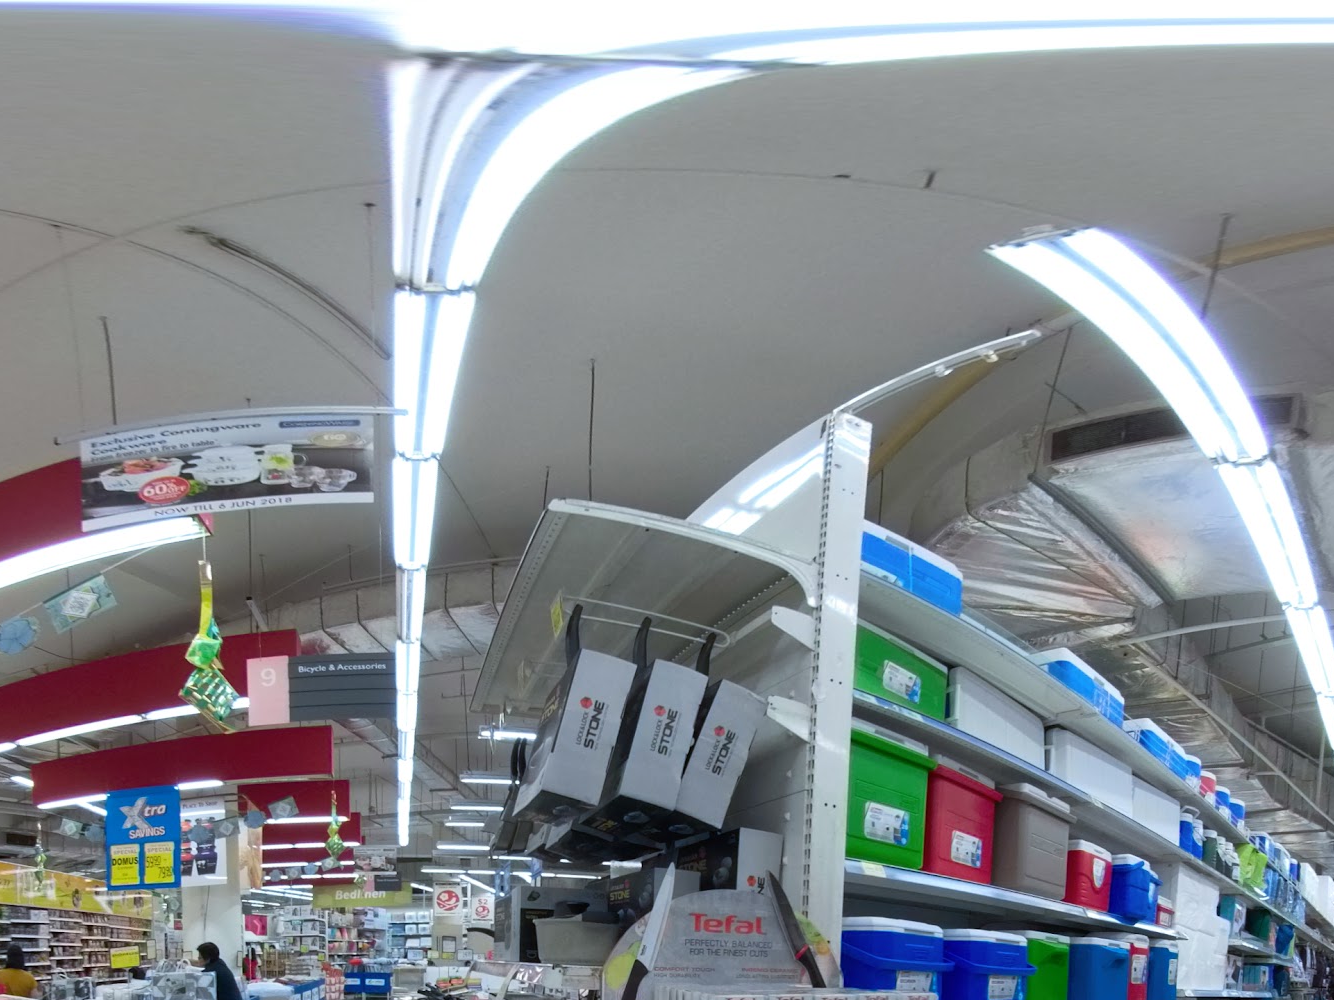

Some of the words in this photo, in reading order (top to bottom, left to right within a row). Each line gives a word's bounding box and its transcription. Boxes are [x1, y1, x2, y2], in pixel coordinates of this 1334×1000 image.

[154, 505, 190, 517] NOW
[193, 503, 217, 512] TILL
[218, 502, 227, 510] 6
[227, 499, 257, 510] JUN
[260, 496, 294, 506] 2018
[297, 664, 327, 674] Bicycle
[328, 663, 336, 671] &
[336, 662, 387, 671] Accessories
[260, 667, 277, 688] 9
[583, 699, 605, 750] STONE
[657, 708, 678, 756] STONE
[711, 729, 736, 776] STONE
[119, 796, 167, 830] Xtra
[128, 825, 166, 840] SAVINGS
[111, 856, 139, 866] DOMUS
[335, 888, 387, 901] Bedlnen
[609, 889, 631, 902] STONE
[689, 912, 767, 935] Tefal
[684, 938, 729, 948] PERFECTLY
[731, 939, 773, 950] BALANCED
[689, 947, 705, 956] FOR
[706, 948, 720, 956] THE
[721, 948, 744, 957] FINEST
[744, 949, 769, 958] CUTS
